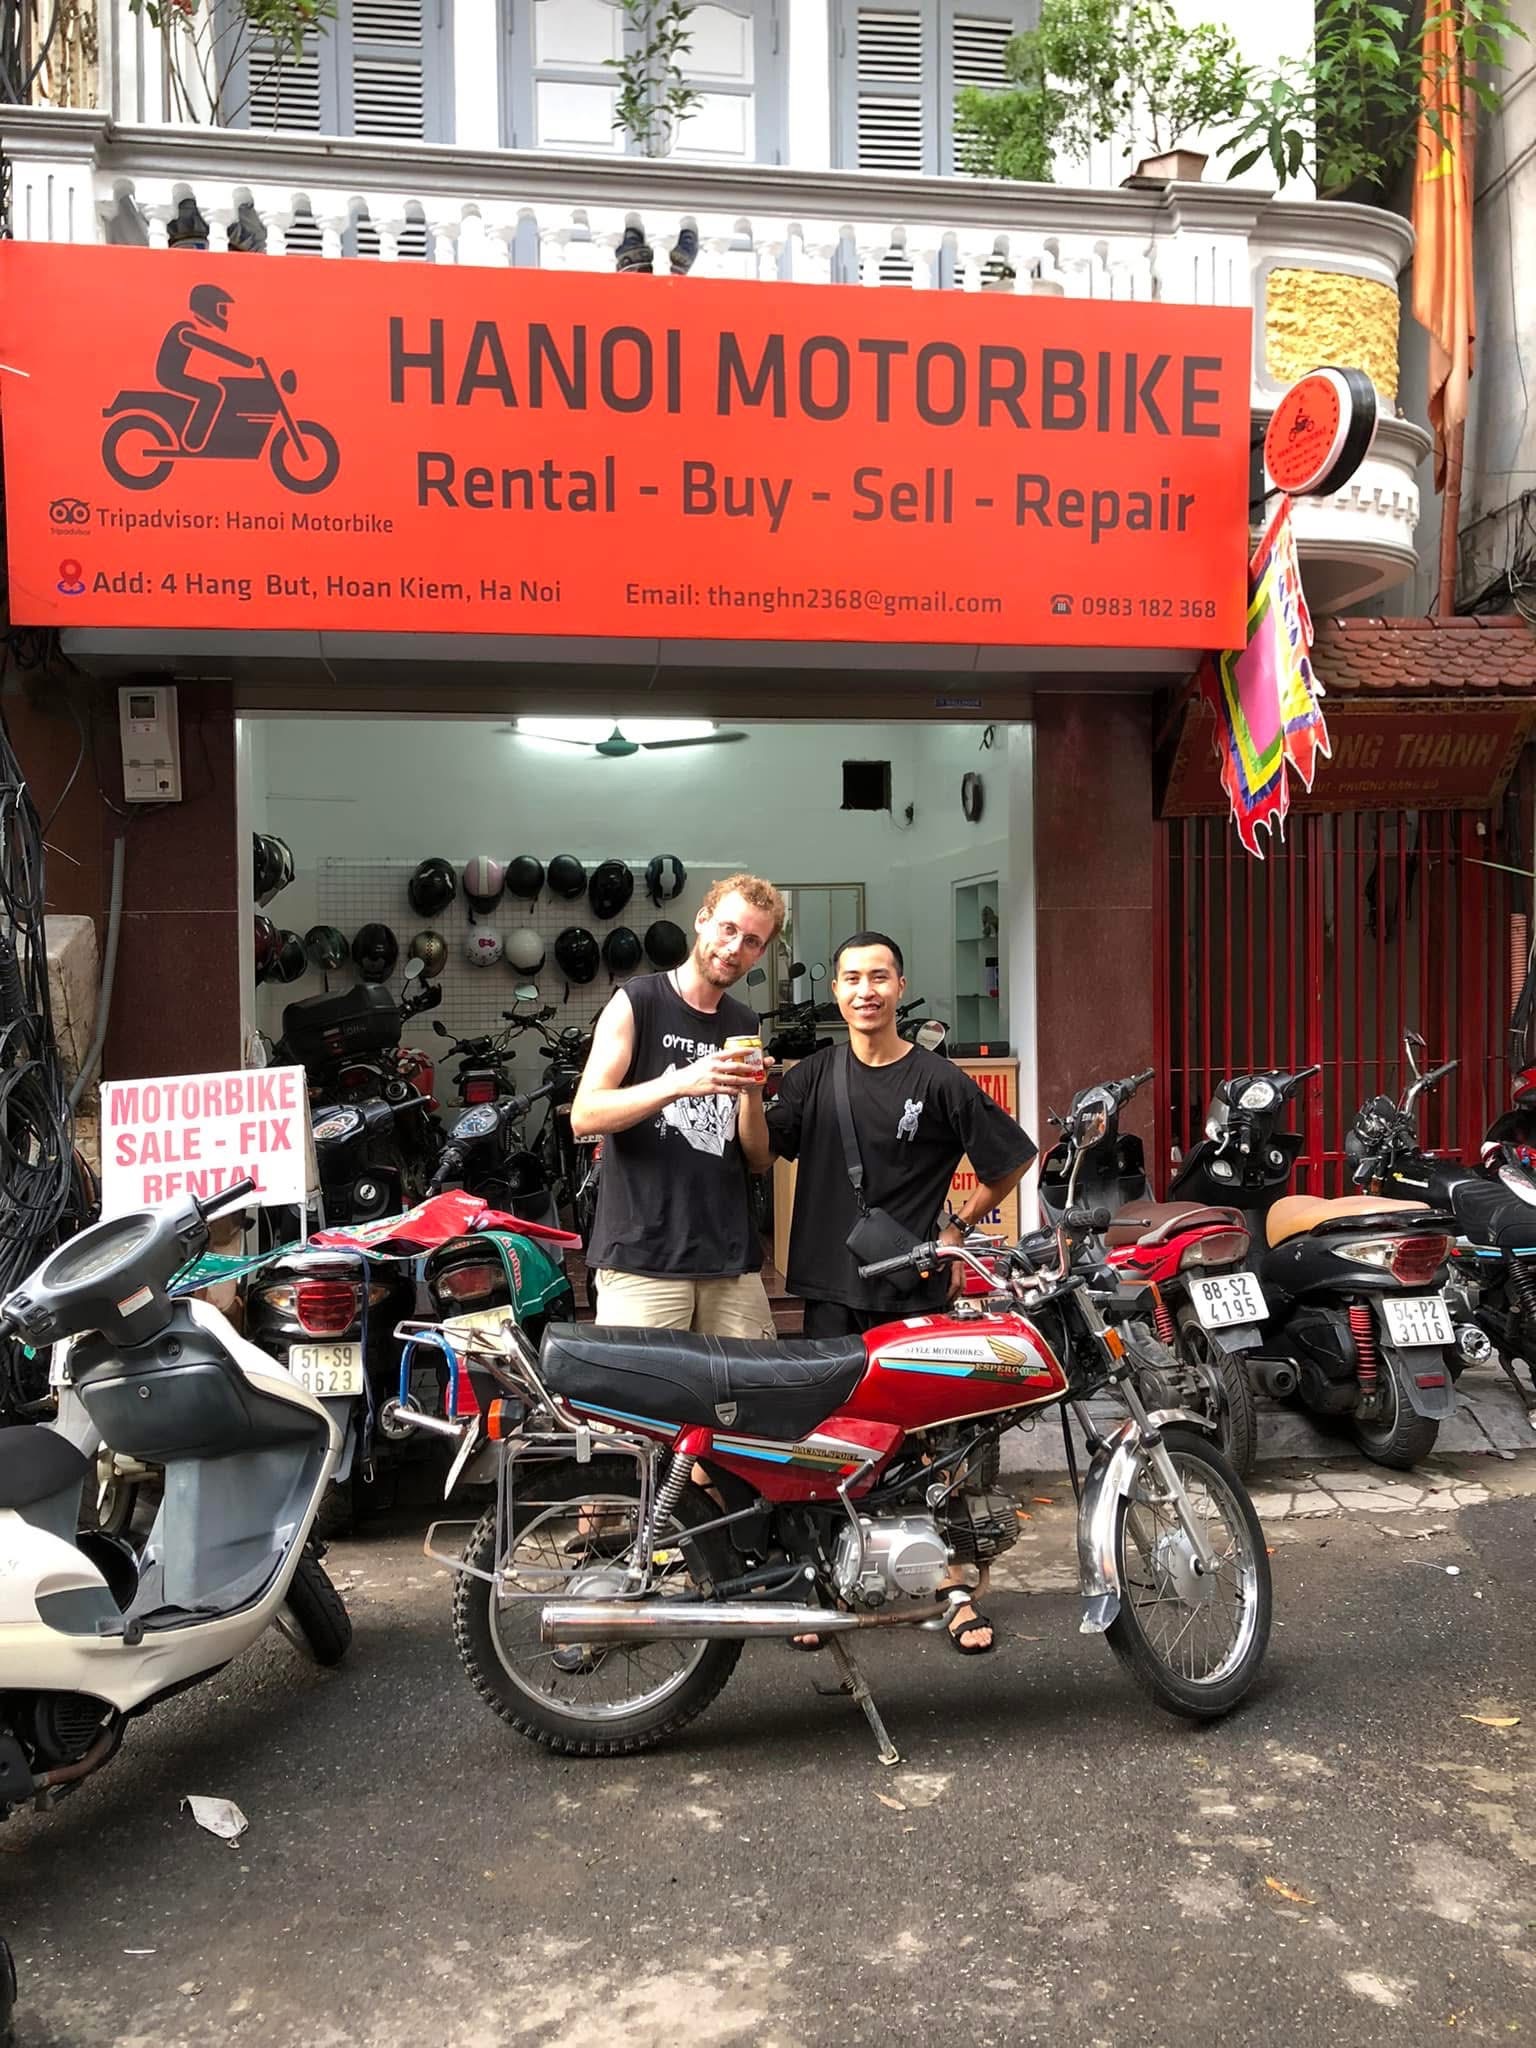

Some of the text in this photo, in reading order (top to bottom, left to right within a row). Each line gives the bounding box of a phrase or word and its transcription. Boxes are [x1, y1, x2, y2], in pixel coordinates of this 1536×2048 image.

[389, 316, 681, 414] HANOI
[716, 331, 1222, 438] MOTORBIKE
[417, 451, 1195, 545] Rental - Buy - Sell - Repair
[95, 508, 393, 533] Tripadvisor: Hanoi Motorbike
[92, 571, 560, 602] Add: 4 Hang But, Hoan Kiem, Ha Noi
[626, 583, 1003, 616] Email: thanghn2368@gmail.com
[1082, 597, 1216, 618] 0983 182 368
[111, 1072, 297, 1126] MOTORBIKE
[115, 1127, 202, 1167] SALE
[240, 1118, 292, 1155] FIX
[1202, 1277, 1251, 1301] 88-S2
[1211, 1297, 1257, 1322] 4195
[1401, 1321, 1445, 1343] 3116
[974, 1363, 1020, 1374] ESPERO
